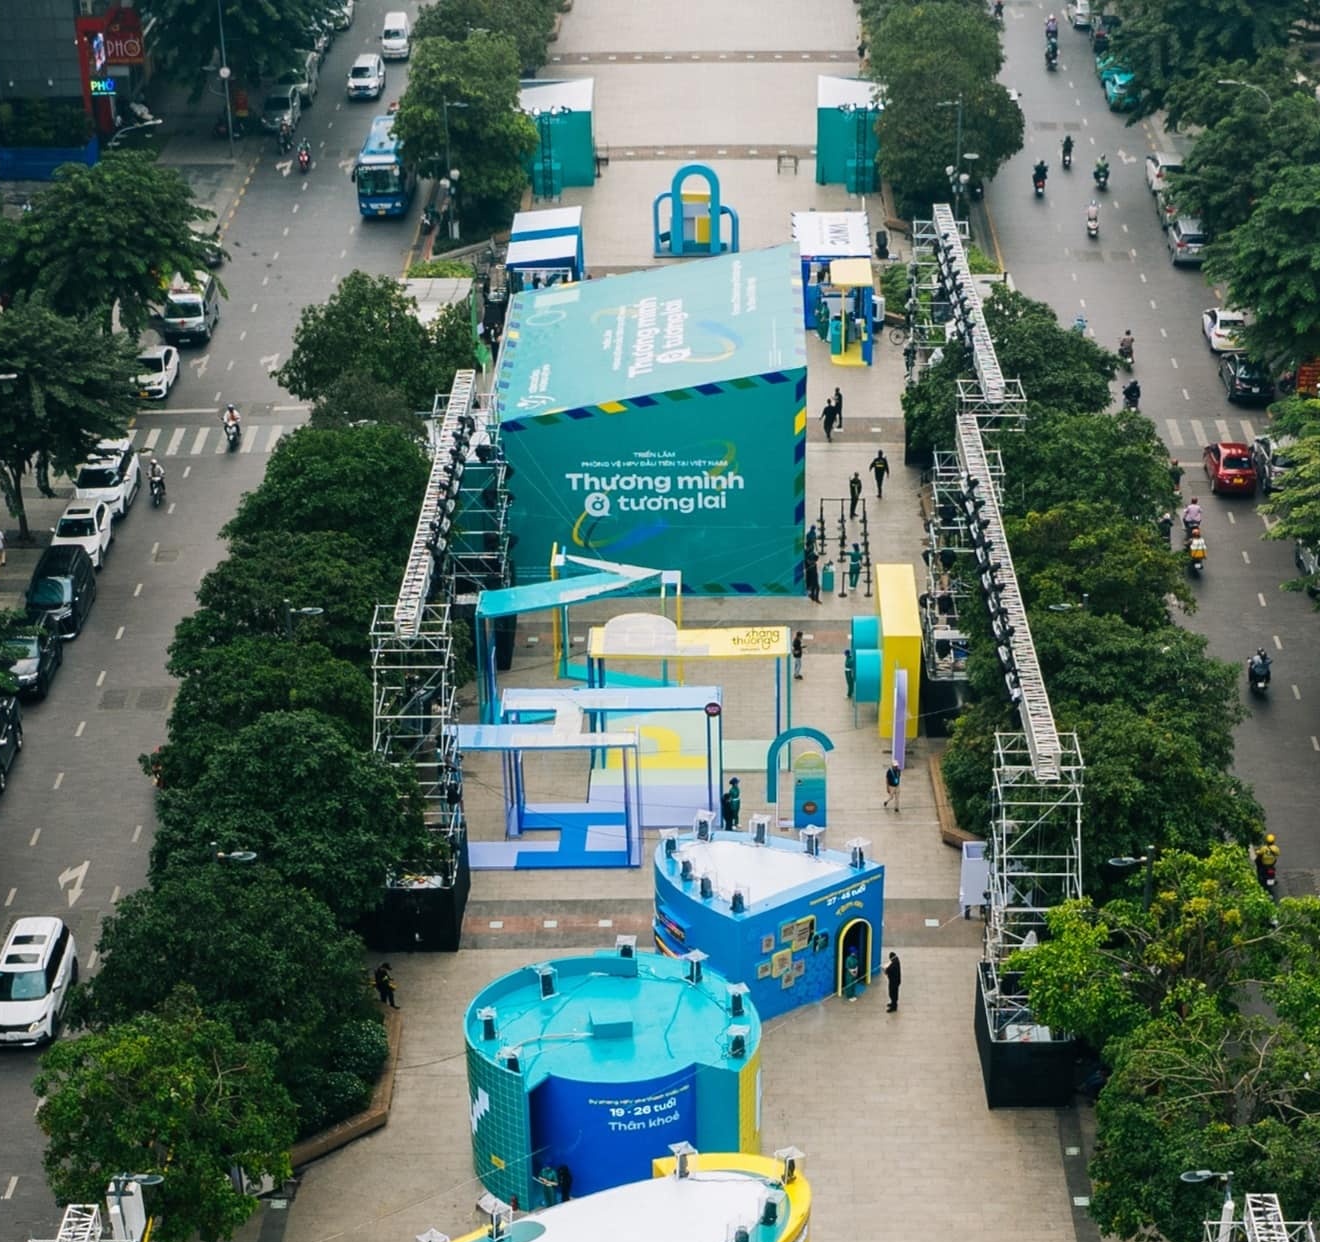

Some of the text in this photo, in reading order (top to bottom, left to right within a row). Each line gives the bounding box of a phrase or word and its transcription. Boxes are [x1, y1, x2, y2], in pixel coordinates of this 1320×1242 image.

[565, 470, 744, 493] Thương mình
[617, 490, 727, 513] tương lai
[610, 1097, 677, 1117] 19 26 tuổi
[608, 1121, 646, 1132] Thân
